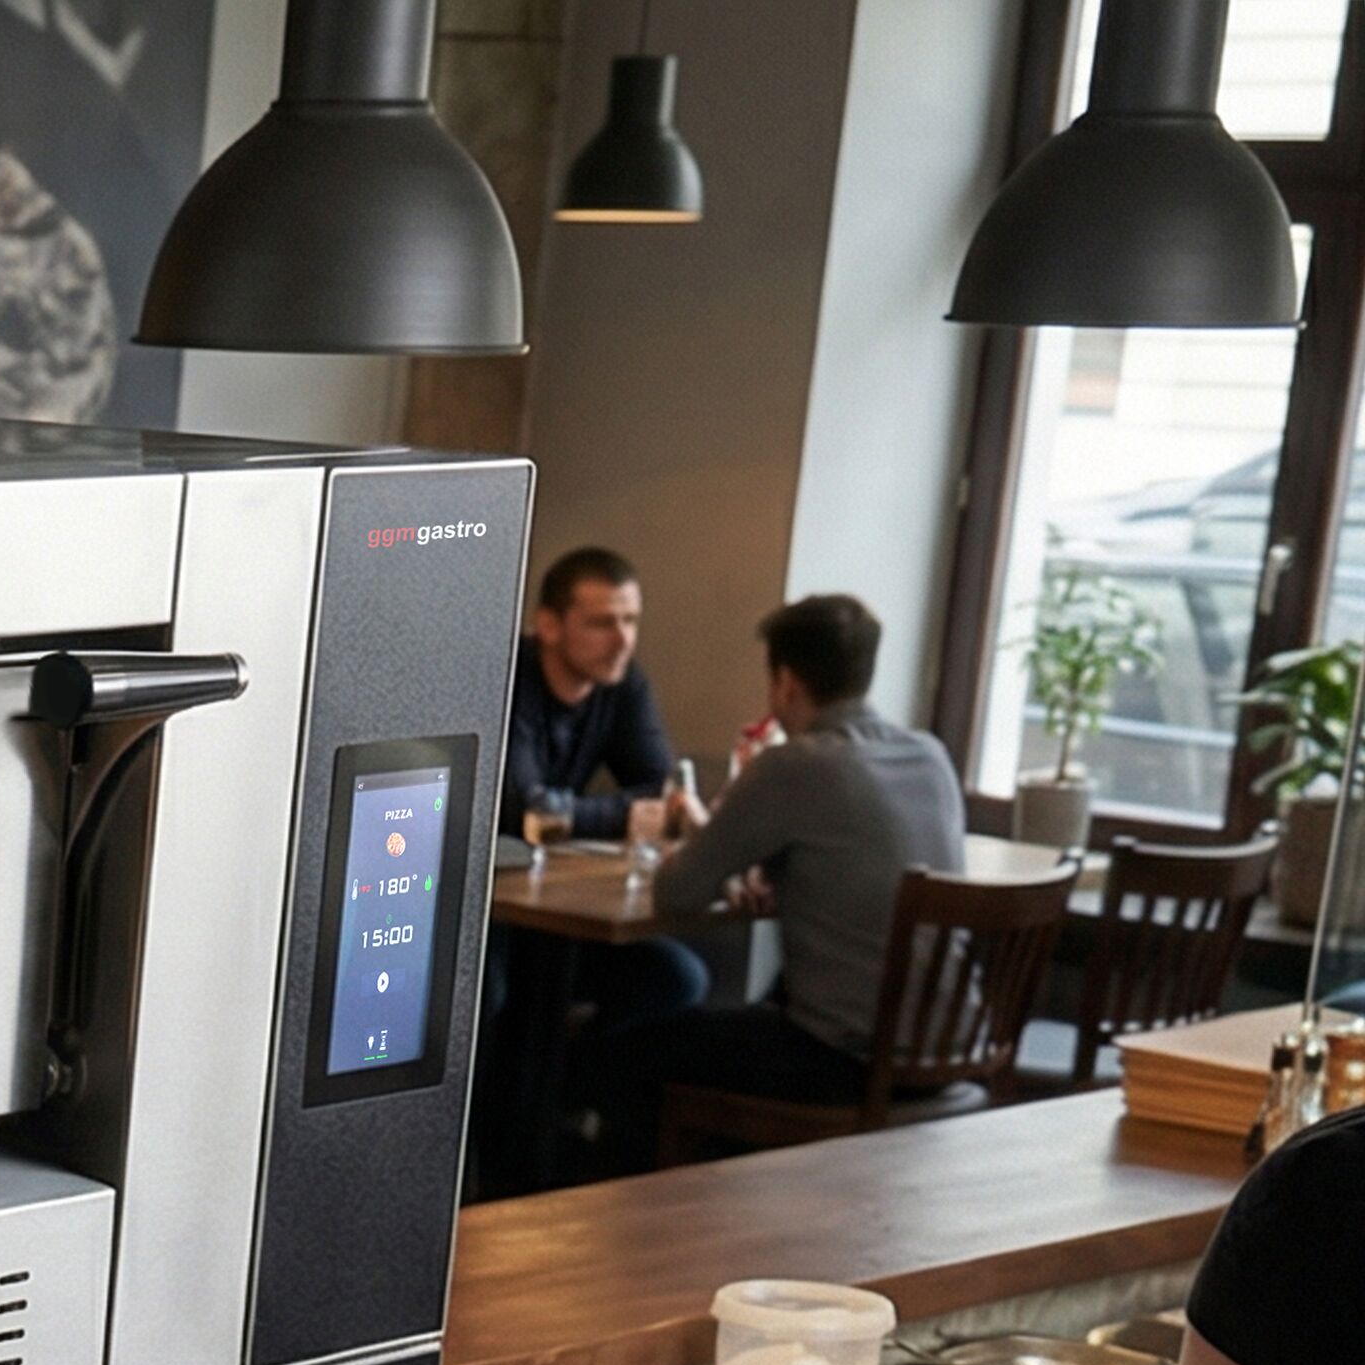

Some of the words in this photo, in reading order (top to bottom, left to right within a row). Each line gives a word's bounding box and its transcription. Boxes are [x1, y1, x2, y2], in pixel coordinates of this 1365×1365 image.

[367, 520, 487, 548] ggmgastro
[384, 808, 414, 821] PIZZA
[362, 925, 414, 949] 15:00
